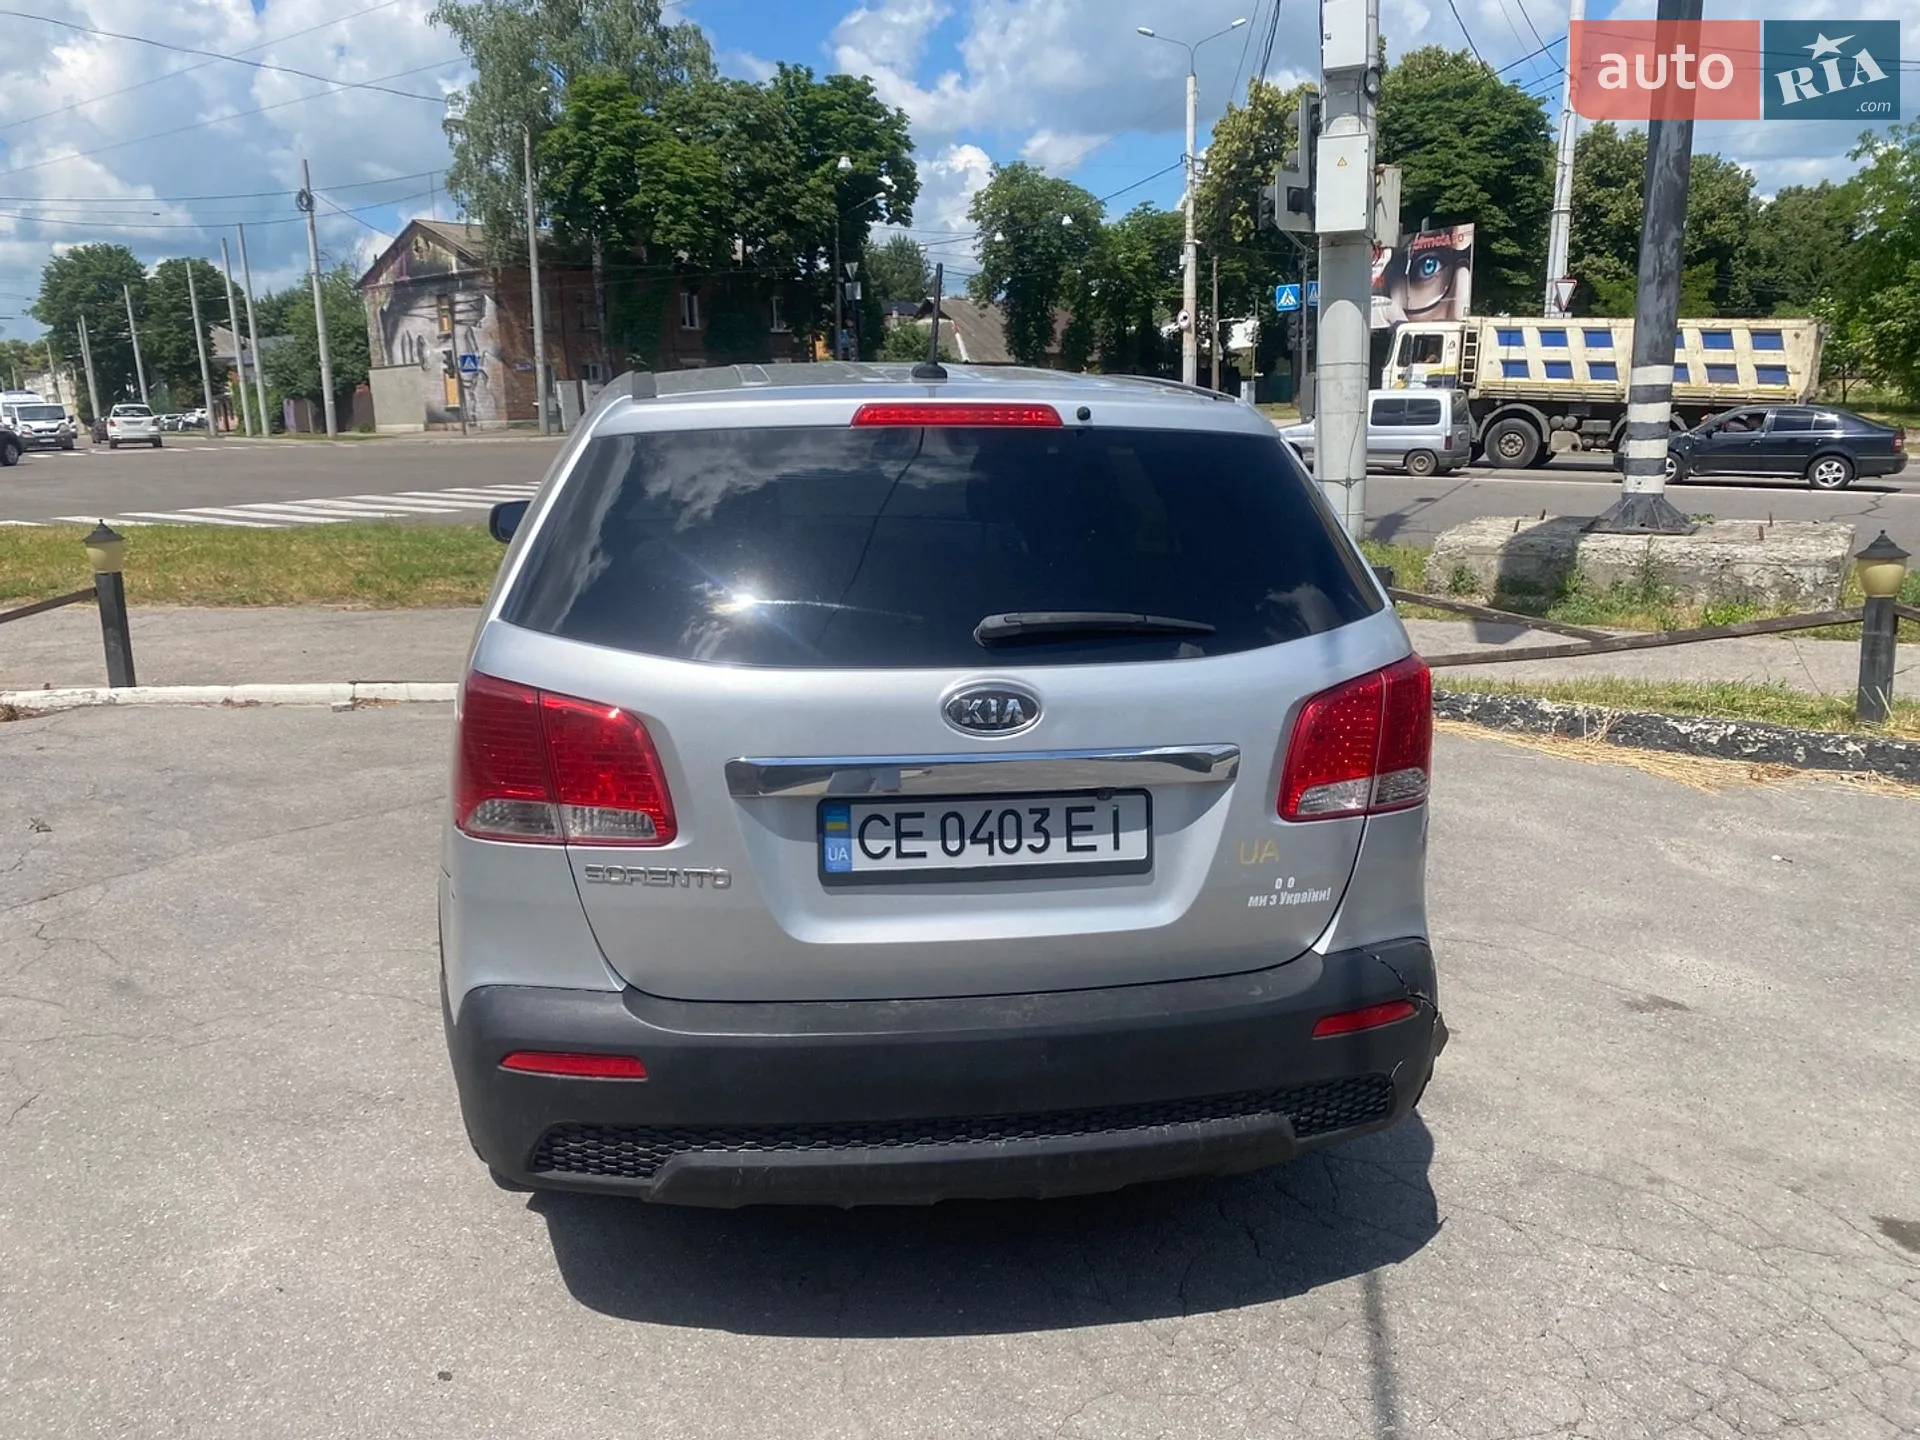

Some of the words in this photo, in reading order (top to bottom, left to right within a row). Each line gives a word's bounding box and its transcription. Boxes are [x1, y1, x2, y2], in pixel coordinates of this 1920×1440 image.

[960, 698, 1025, 724] KIA
[858, 811, 927, 860] CE
[940, 807, 1051, 857] 0403
[828, 850, 849, 862] UA
[1239, 839, 1279, 864] UA
[585, 864, 732, 889] SORENTO
[1279, 886, 1332, 905] України!
